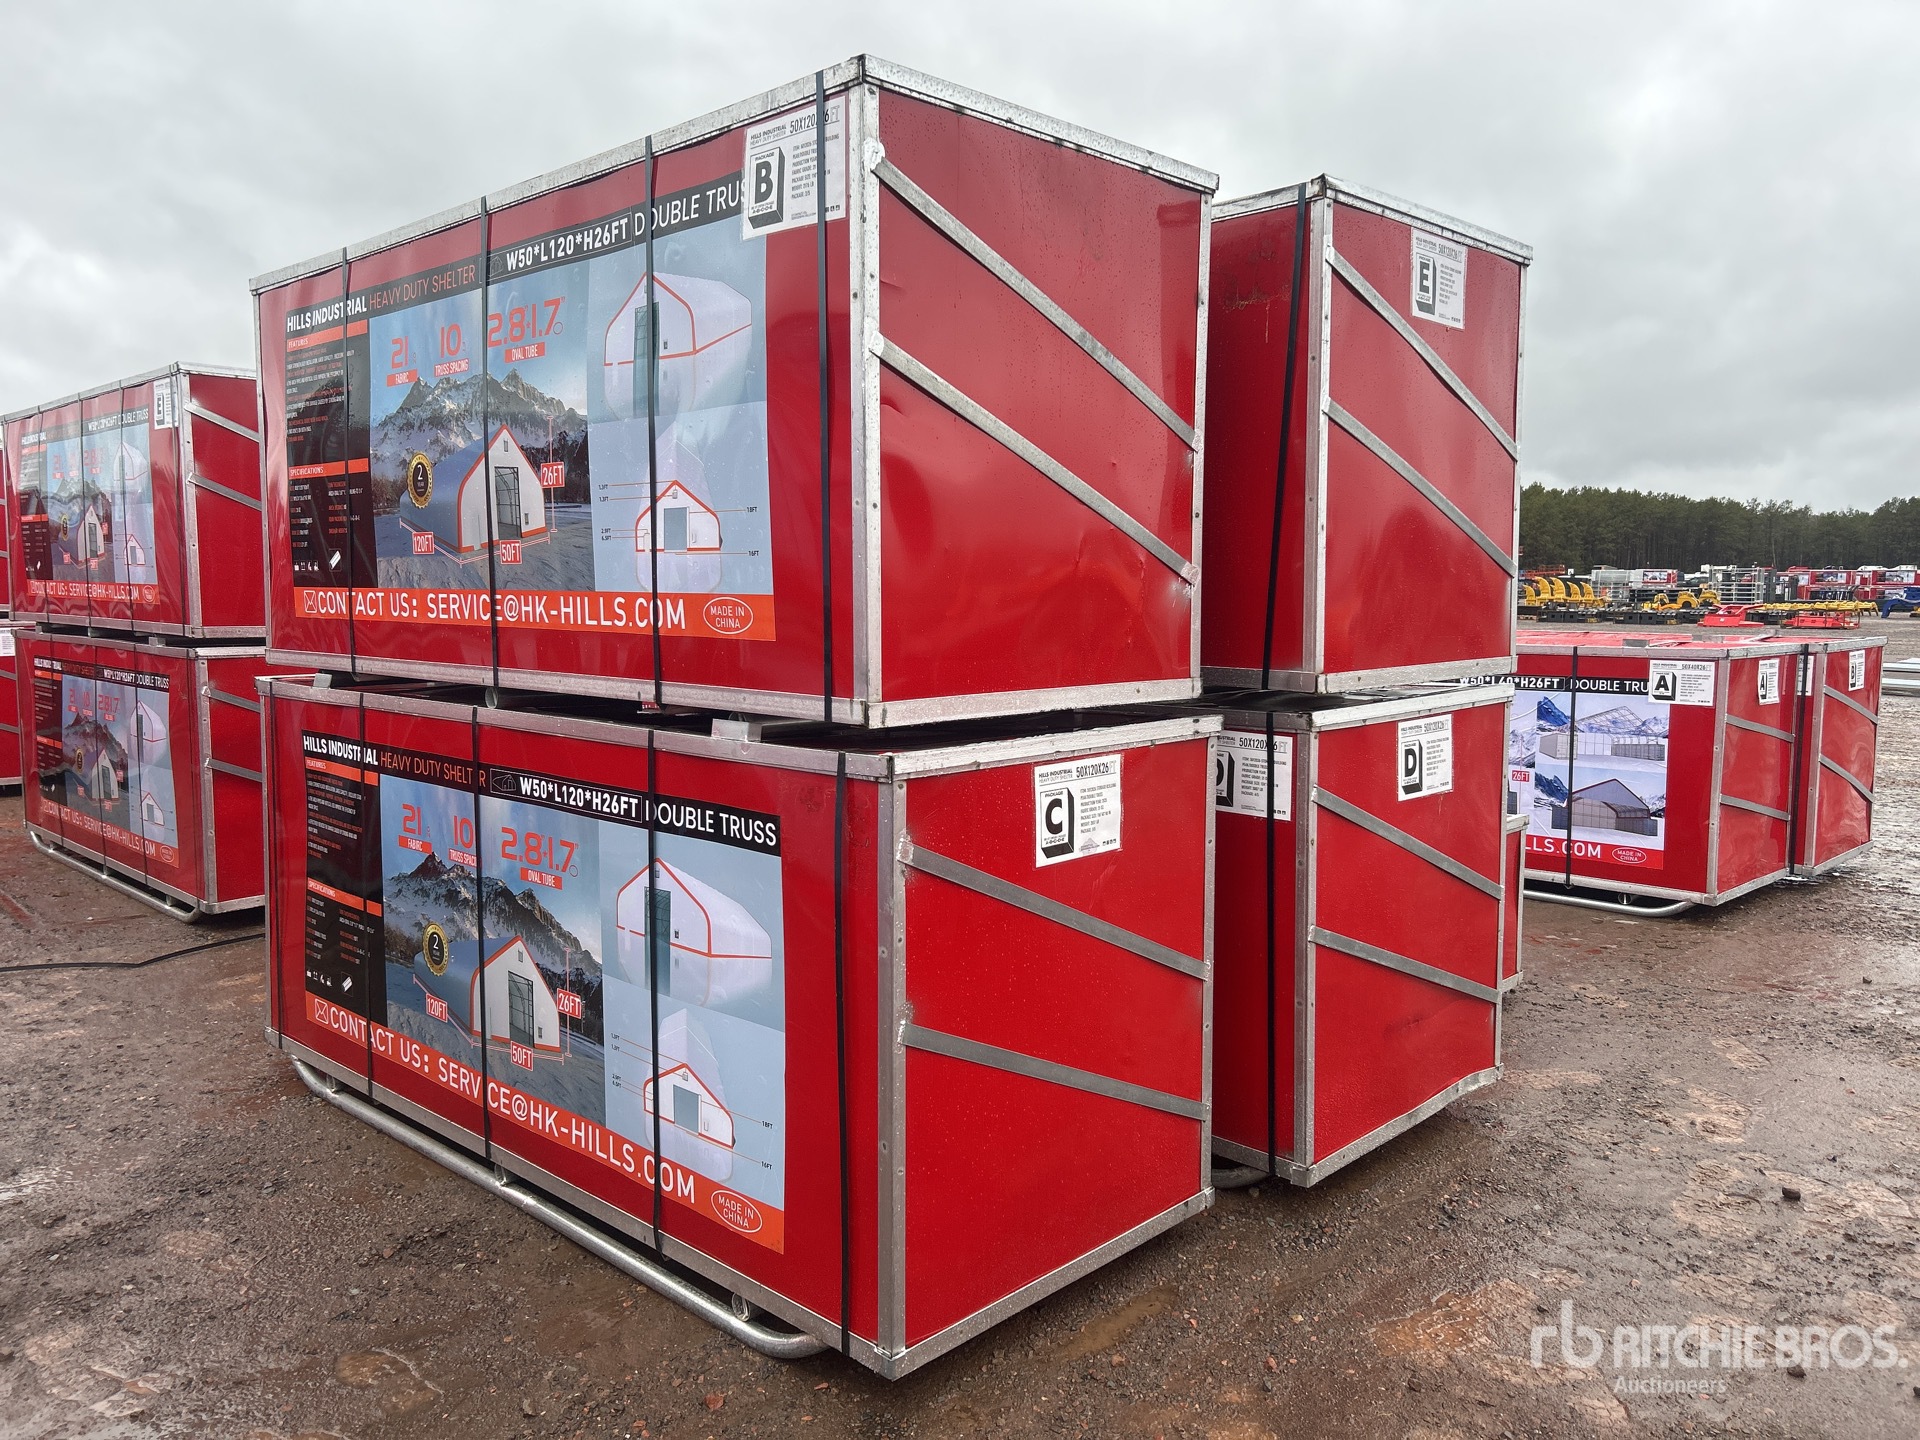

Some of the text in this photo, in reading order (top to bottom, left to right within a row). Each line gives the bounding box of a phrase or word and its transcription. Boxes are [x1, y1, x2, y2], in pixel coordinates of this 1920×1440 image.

[750, 132, 762, 140] HILLS
[762, 124, 786, 136] INDUSTRIAL
[754, 160, 774, 204] B
[1419, 260, 1430, 294] E
[286, 311, 312, 332] HILLS
[312, 296, 367, 326] INDUSTRIAL
[370, 286, 400, 310] HEAVY
[404, 278, 428, 301] DUTY
[432, 264, 476, 294] SHELTER
[288, 338, 308, 348] FEATURES
[391, 336, 408, 369] 21
[439, 323, 462, 358] 10
[512, 344, 538, 361] OVAL TUBE
[435, 359, 469, 378] TRUSS SPACING
[136, 408, 148, 422] TRUSS
[290, 466, 324, 476] SPECIFICATIONS
[418, 464, 423, 480] 2
[542, 465, 564, 486] 26FT
[414, 534, 432, 552] 120FT
[502, 544, 520, 562] 50FT
[58, 582, 68, 596] US:
[390, 592, 418, 618] US:
[427, 593, 686, 630] SERVICE@HK-HILLS.COM
[710, 606, 745, 617] MADE IN
[715, 618, 740, 628] CHINA
[155, 676, 170, 689] TRUSS
[1570, 679, 1620, 692] DOUBLE
[1624, 680, 1650, 692] TRU
[1654, 675, 1670, 691] A
[306, 760, 326, 770] FEATURES
[1050, 768, 1072, 776] INDUSTRIAL
[1404, 748, 1417, 778] D
[1512, 772, 1530, 781] 26FT
[303, 736, 327, 754] HILLS
[380, 752, 411, 770] HEAVY
[414, 758, 442, 777] DUTY
[444, 762, 486, 788] SHELTR
[646, 799, 714, 834] DOUBLE
[719, 812, 778, 846] TRUSS
[1046, 798, 1062, 835] C
[402, 804, 422, 836] 21
[454, 816, 474, 849] 10
[450, 850, 463, 864] TRUSS
[528, 870, 556, 888] OVAL TUBE
[433, 934, 439, 950] 2
[426, 997, 447, 1020] 120FT
[558, 992, 580, 1017] 26FT
[512, 1044, 532, 1069] 50FT
[330, 1006, 695, 1204] CONTACT US: SERVCE@HK-HILLS.COM
[762, 1120, 774, 1130] 18FT
[762, 1160, 772, 1170] 16FT
[718, 1194, 754, 1218] MADE IN
[723, 1208, 750, 1228] CHINA
